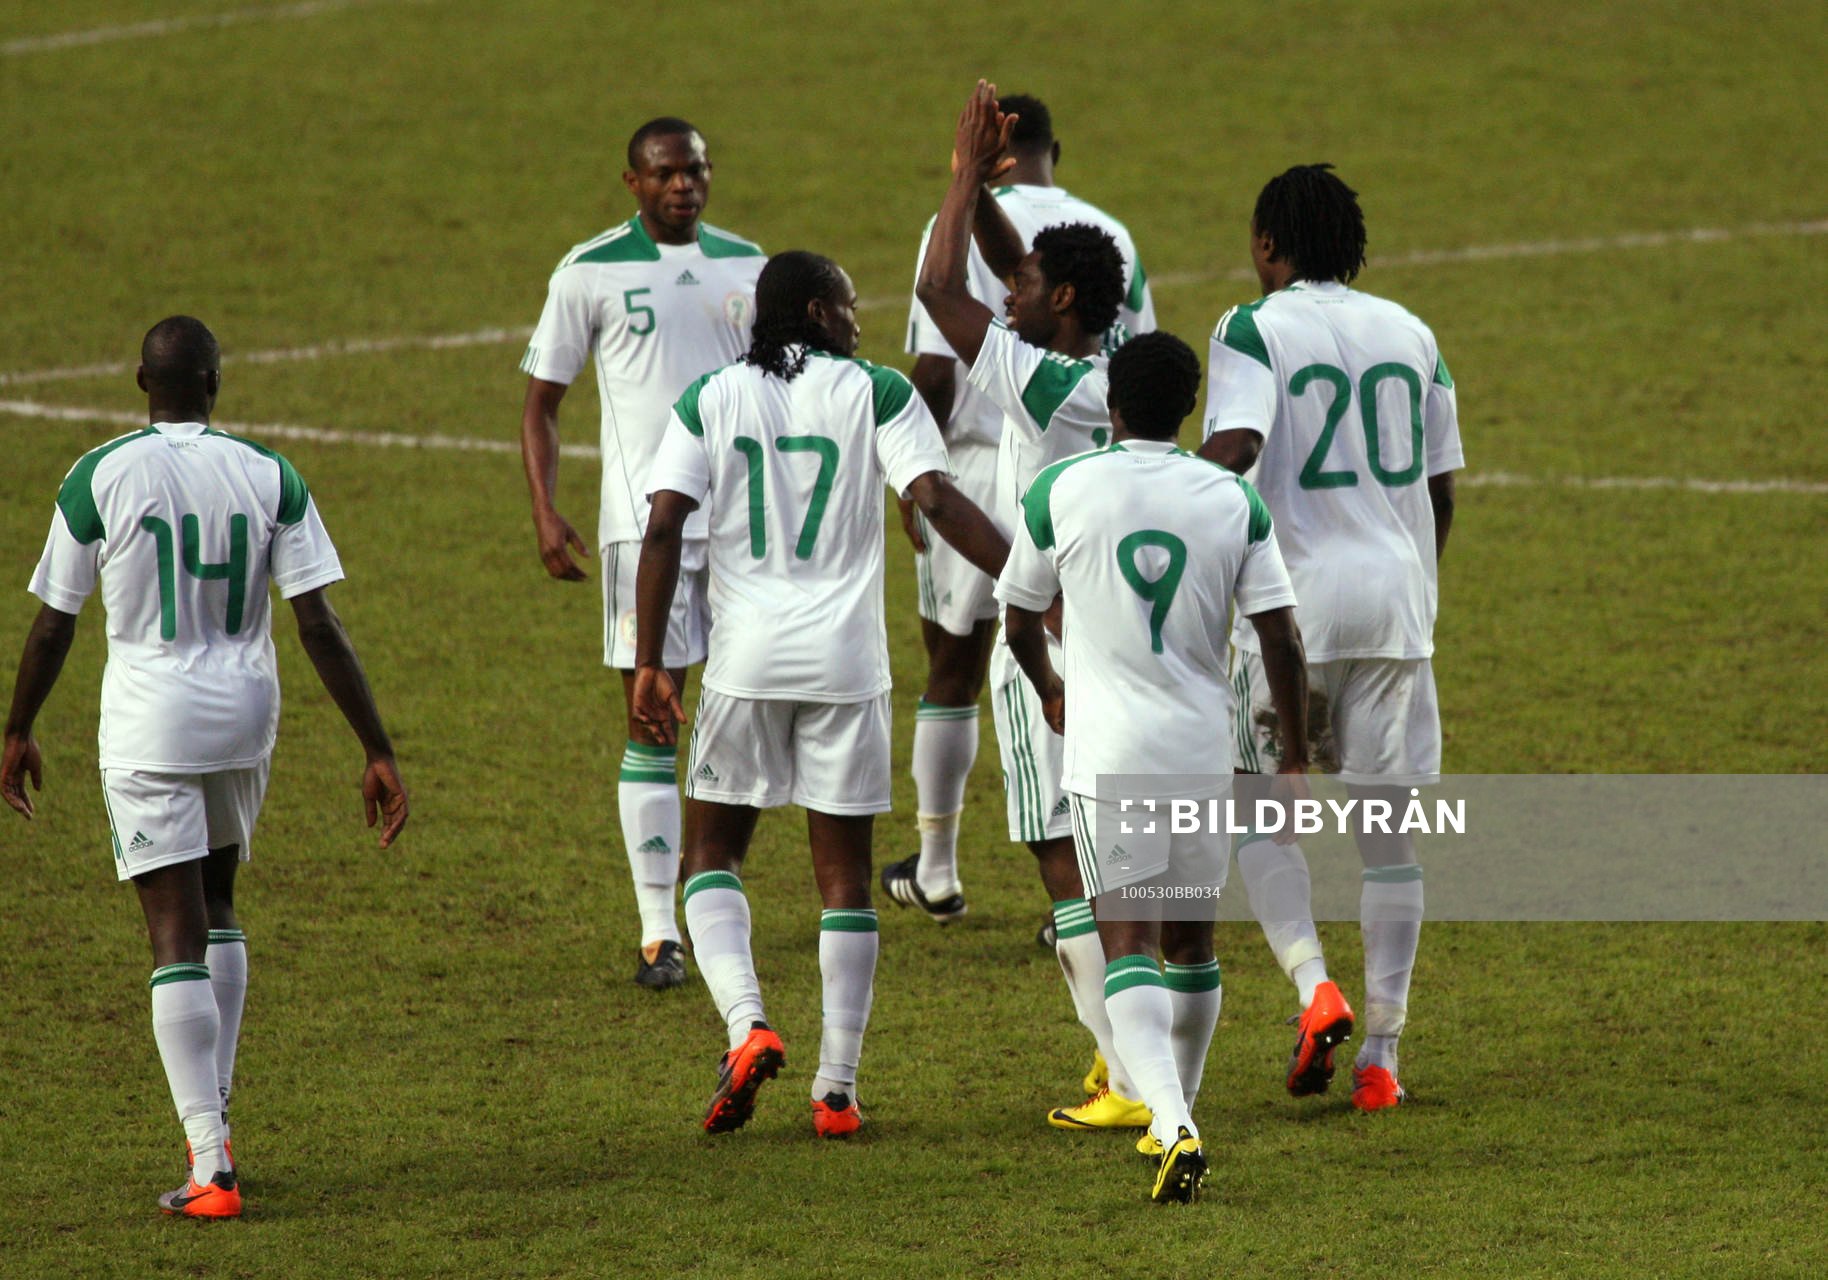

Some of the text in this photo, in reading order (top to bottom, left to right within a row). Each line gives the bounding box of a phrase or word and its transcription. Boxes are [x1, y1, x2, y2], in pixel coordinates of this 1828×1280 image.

[623, 287, 656, 336] 5
[1289, 361, 1424, 489] 20
[734, 434, 841, 560] 17
[142, 513, 249, 641] 14
[1117, 529, 1188, 654] 9
